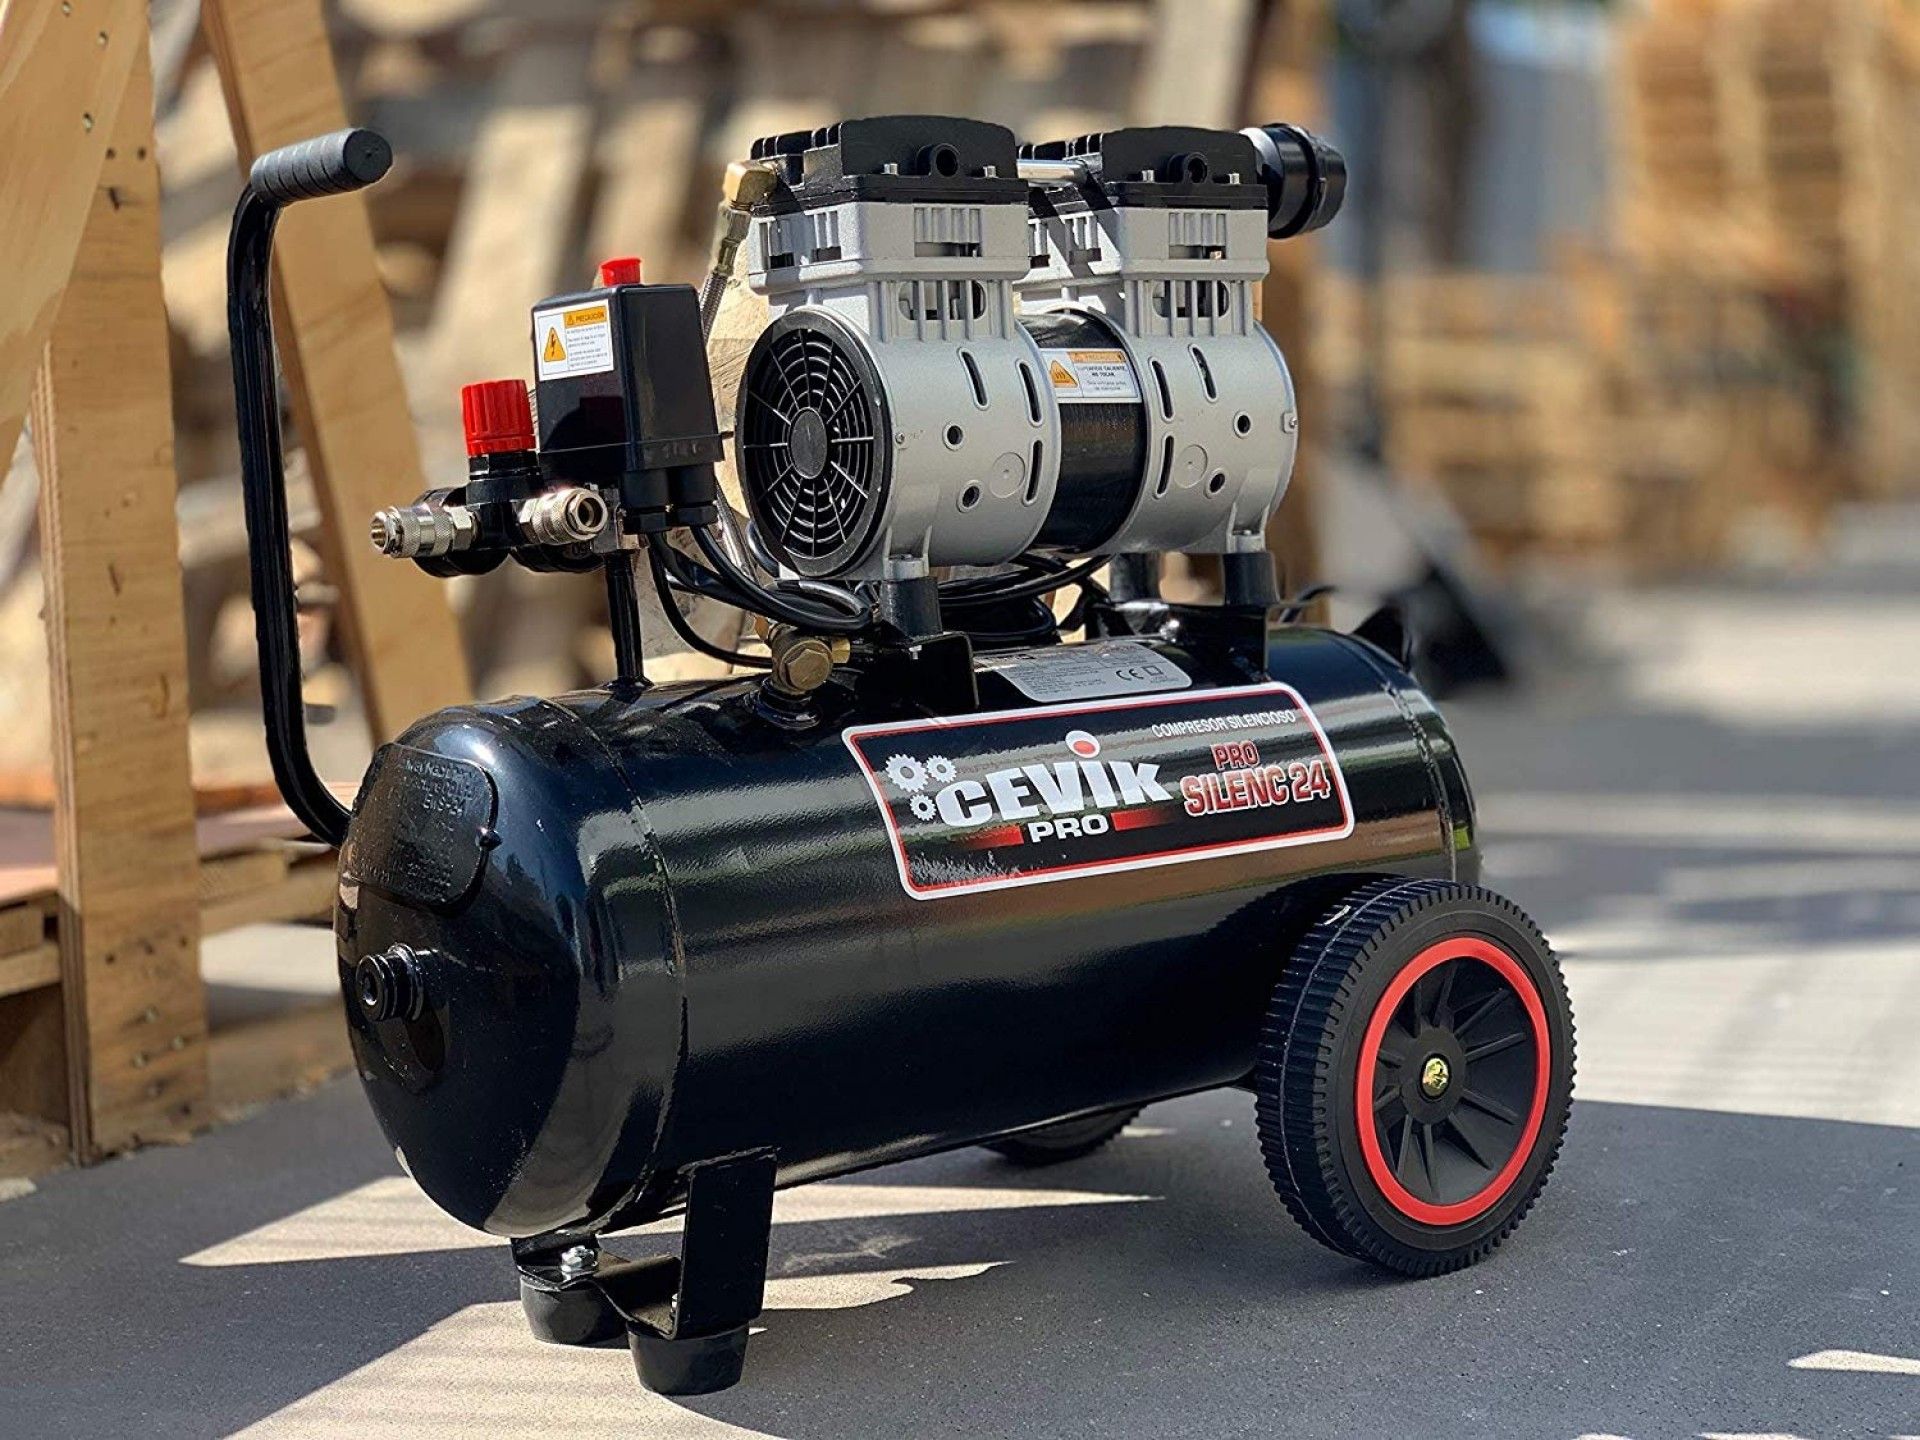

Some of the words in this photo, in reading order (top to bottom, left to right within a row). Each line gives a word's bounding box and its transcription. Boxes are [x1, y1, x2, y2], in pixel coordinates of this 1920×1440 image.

[1152, 717, 1227, 738] COMPRESOR
[1226, 709, 1296, 730] SILENCIOSO
[1211, 740, 1261, 770] PRO
[1180, 765, 1289, 817] SILENC
[1288, 760, 1330, 803] 24
[1028, 814, 1110, 843] PRO
